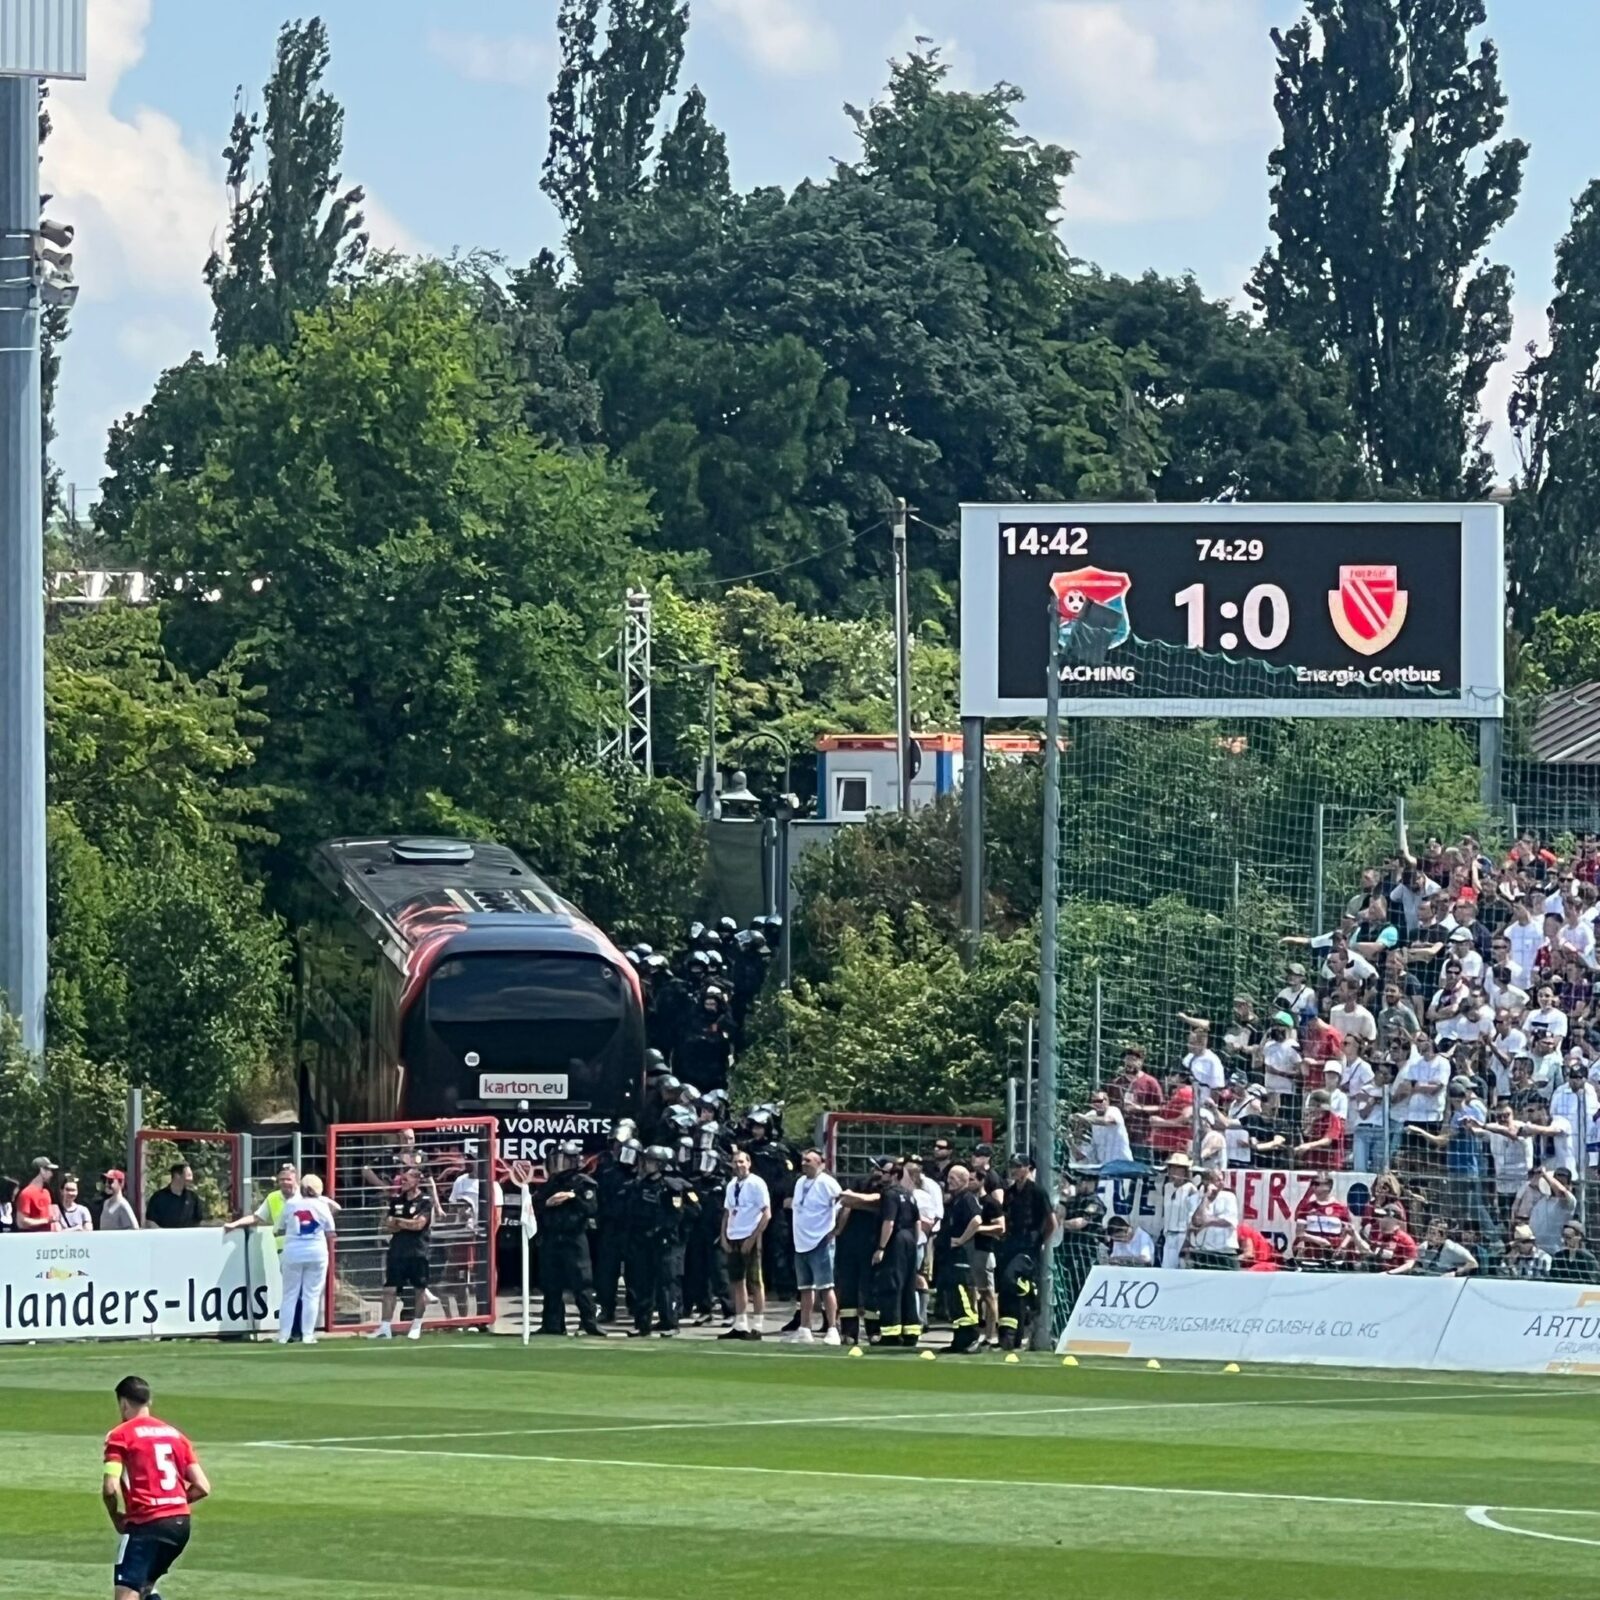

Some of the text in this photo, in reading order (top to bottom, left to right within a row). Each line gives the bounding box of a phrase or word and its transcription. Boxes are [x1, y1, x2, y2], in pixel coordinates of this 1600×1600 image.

[1003, 527, 1088, 556] 14:42
[1196, 538, 1264, 561] 74:29
[1175, 583, 1290, 650] 1:0
[1047, 665, 1136, 682] ACHING
[1369, 666, 1441, 684] Cottbus
[484, 1079, 563, 1094] karton.eu
[504, 1115, 612, 1134] VORWÄRTS
[1085, 1280, 1159, 1309] AKO
[1315, 1320, 1327, 1337] &
[1357, 1322, 1381, 1339] KG
[1523, 1315, 1600, 1339] ARTU
[154, 1443, 177, 1491] 5
